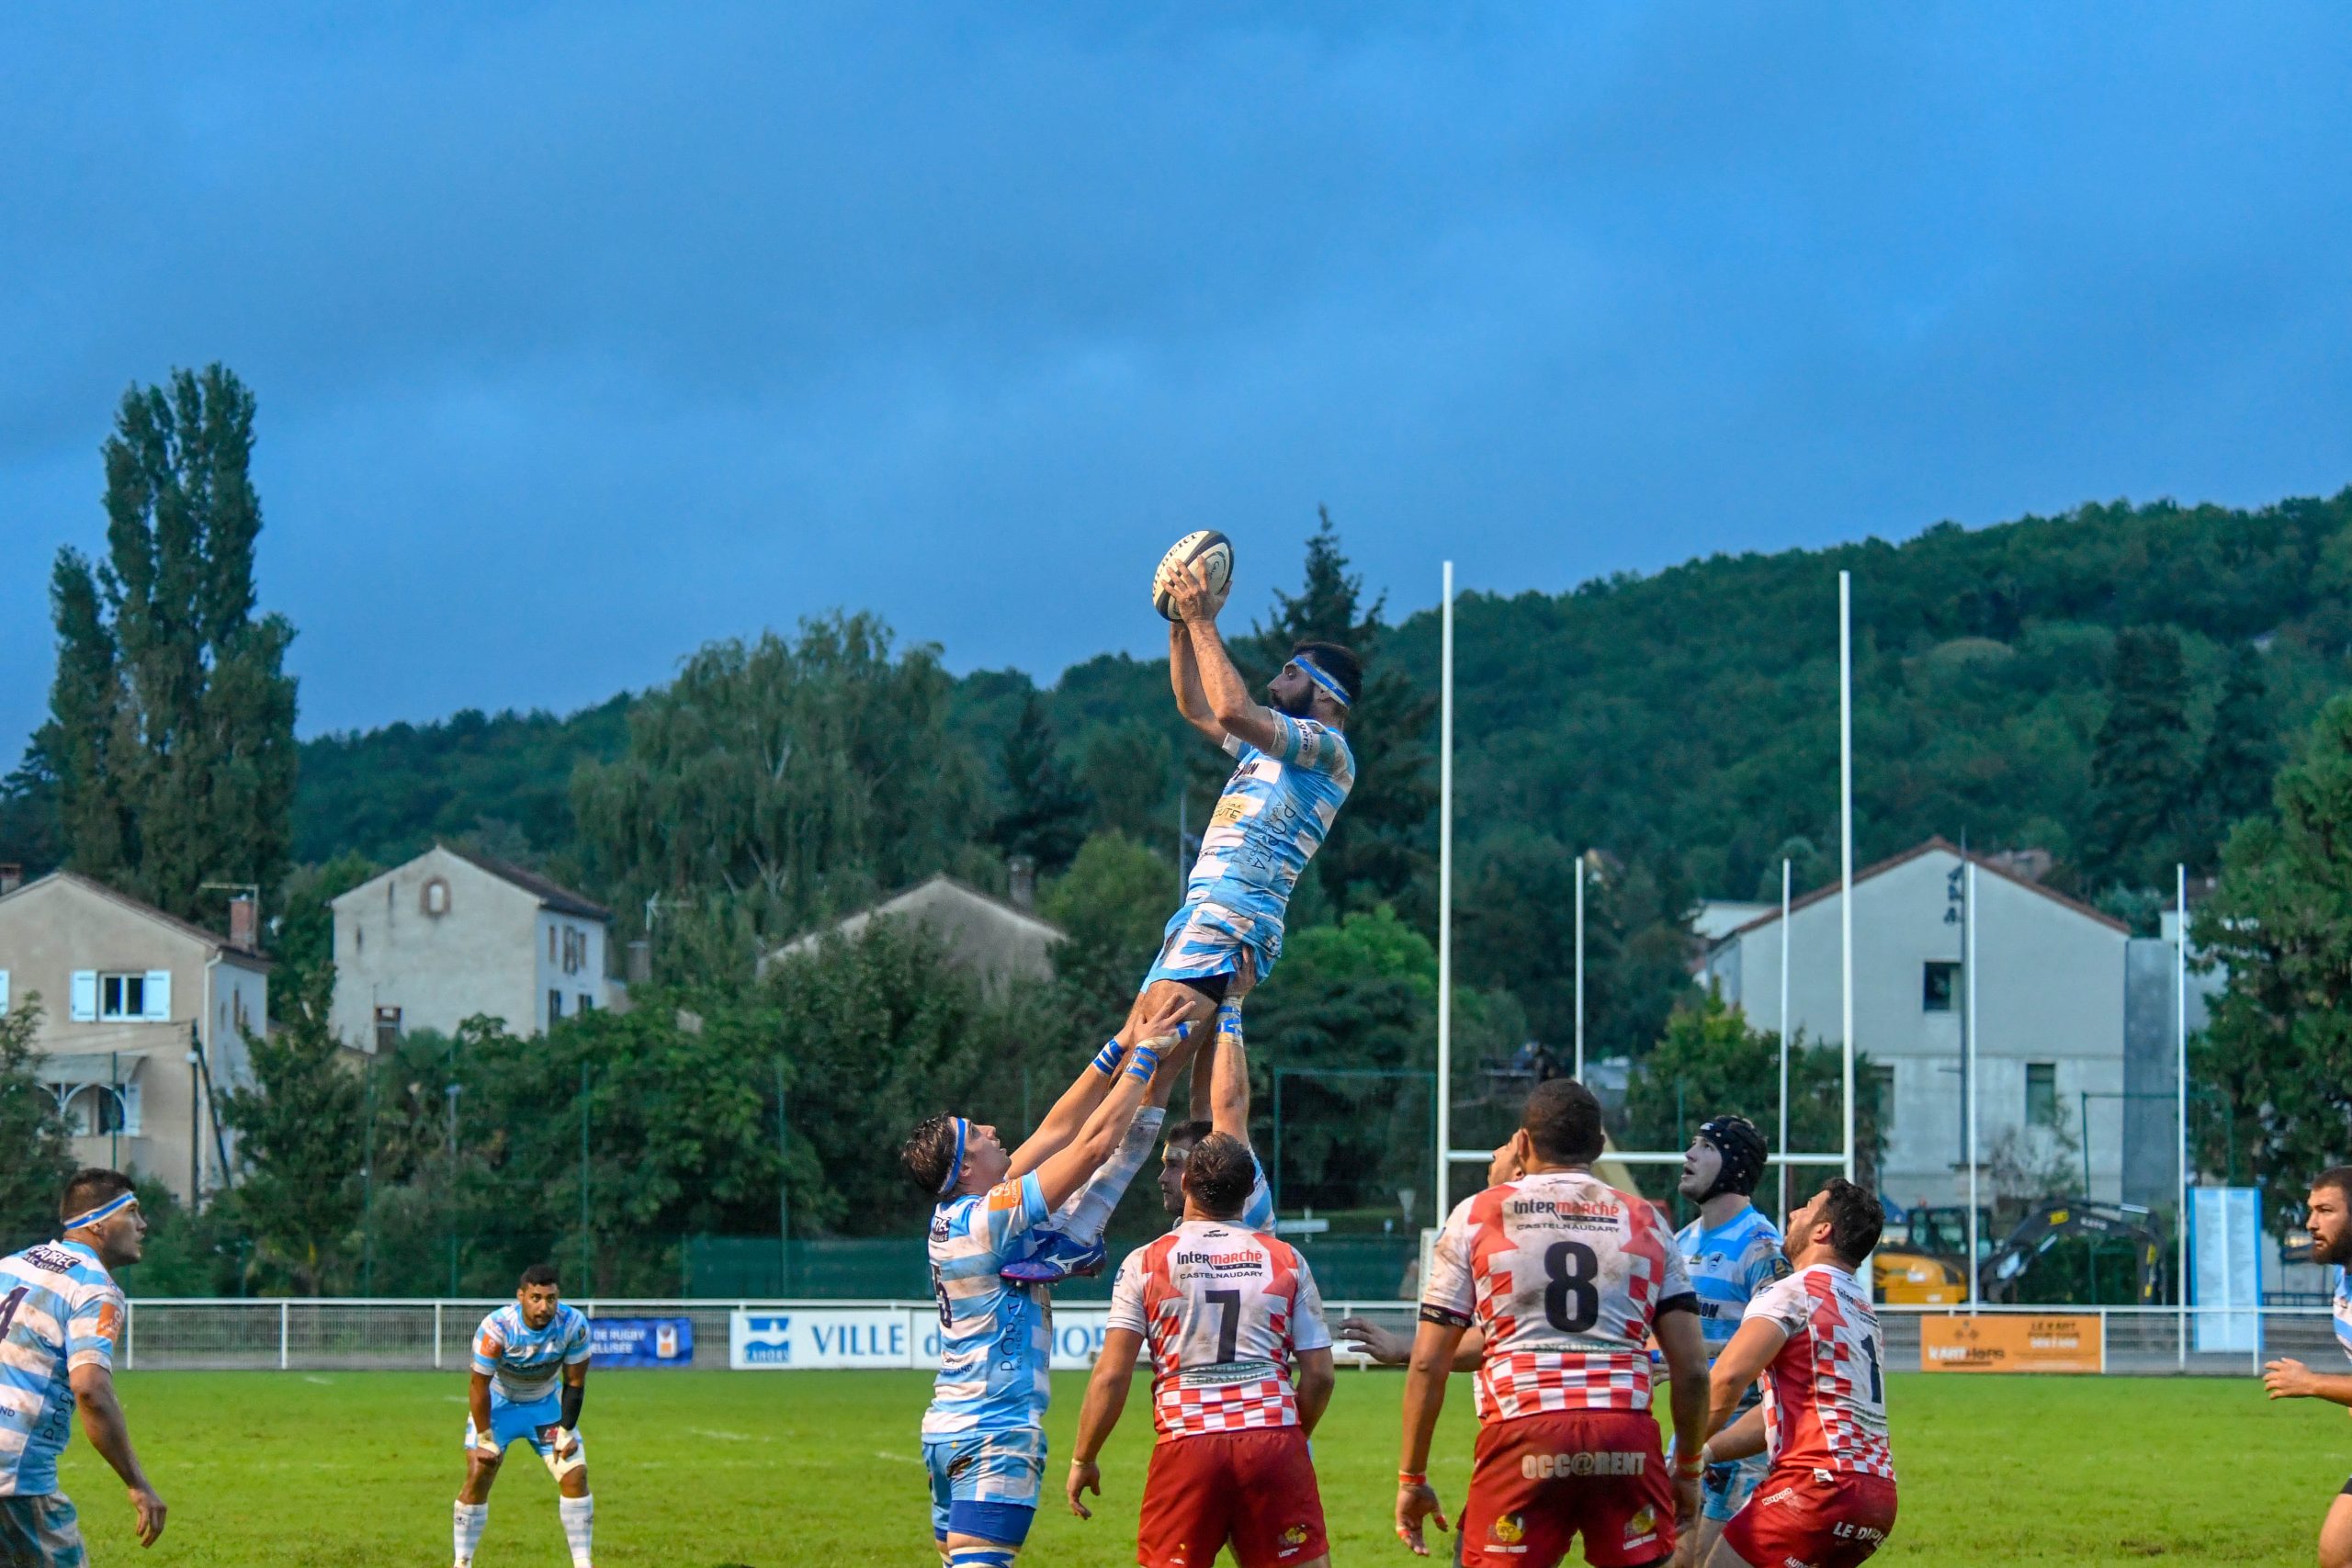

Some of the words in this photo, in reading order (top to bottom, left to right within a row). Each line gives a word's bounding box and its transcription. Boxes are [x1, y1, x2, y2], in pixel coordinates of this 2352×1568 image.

[1516, 1222, 1621, 1234] CASTELNAUDARY
[1180, 1270, 1263, 1280] CASTELNAUDARY
[1544, 1241, 1599, 1333] 8
[593, 1329, 607, 1340] DE
[610, 1329, 645, 1340] RUGBY
[1204, 1289, 1240, 1364] 7
[810, 1323, 904, 1356] VILLE
[1860, 1334, 1882, 1404] 1
[1833, 1521, 1854, 1539] LE
